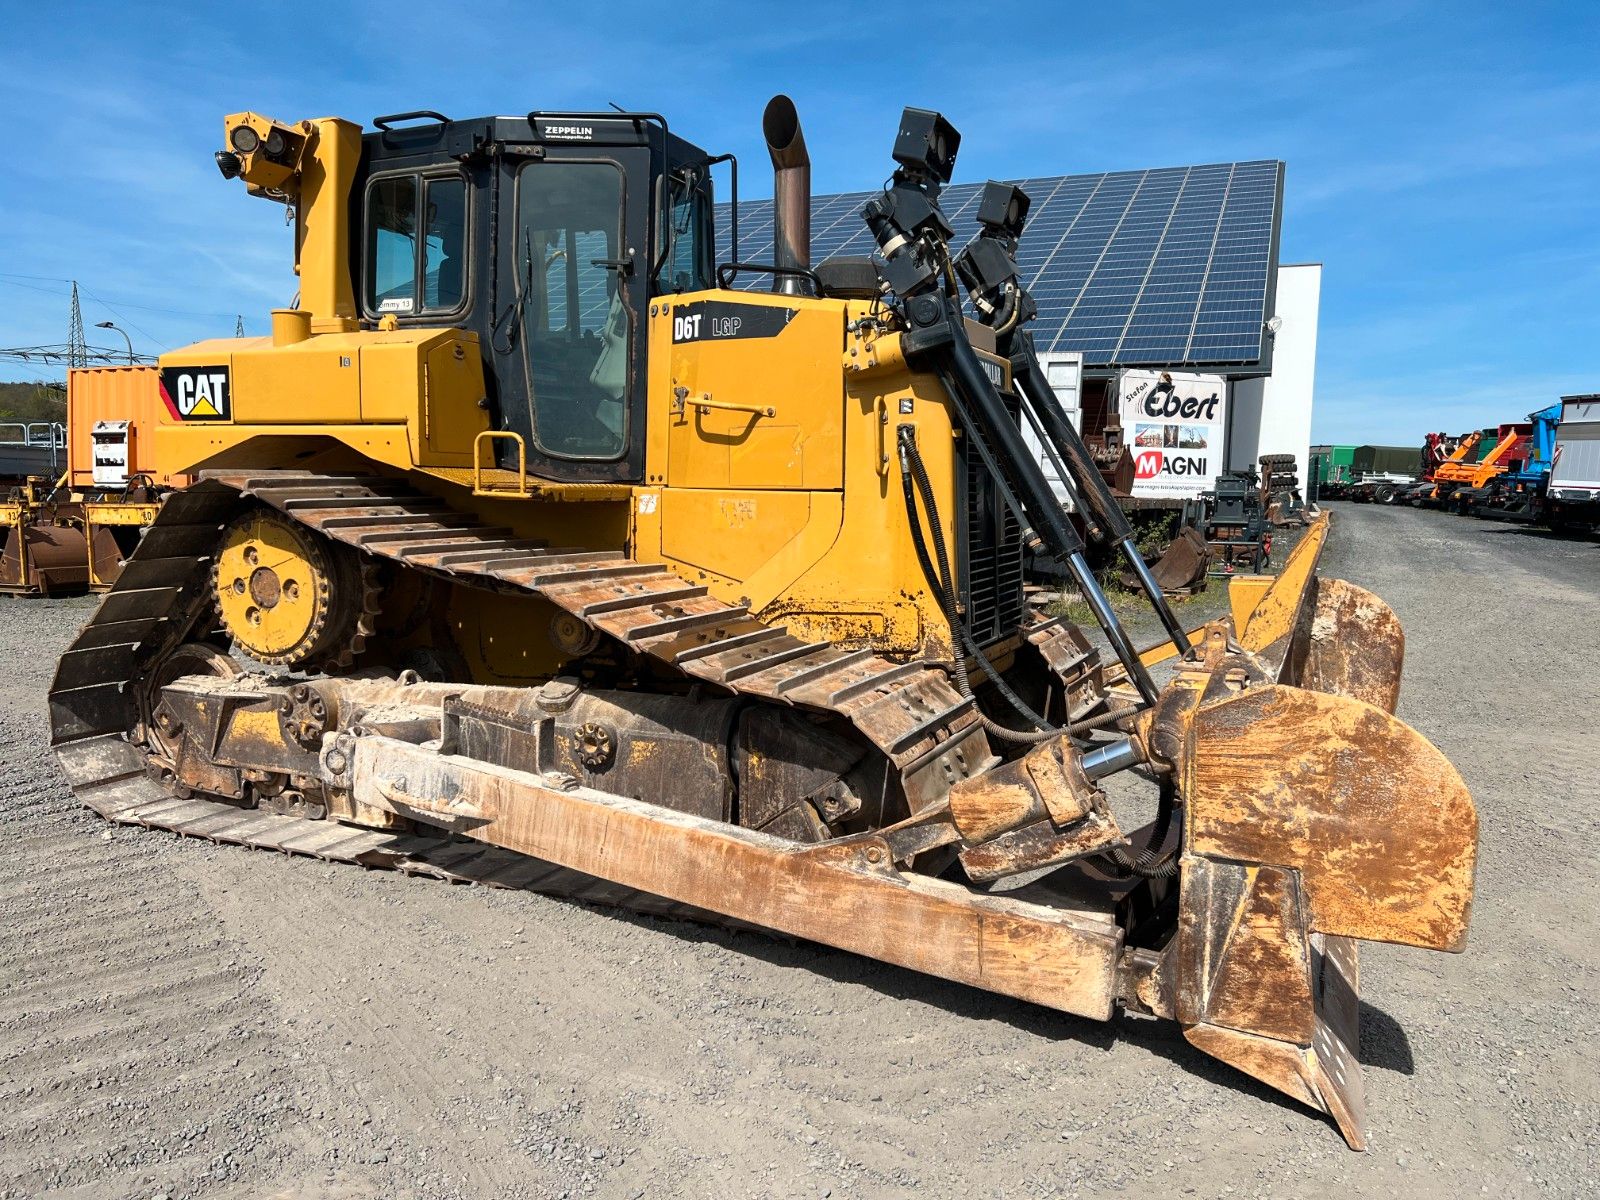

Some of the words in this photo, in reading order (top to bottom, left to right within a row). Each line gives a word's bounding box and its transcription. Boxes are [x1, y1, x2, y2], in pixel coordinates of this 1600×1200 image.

[545, 126, 592, 135] ZEPPELIN
[674, 313, 702, 340] D6T
[712, 317, 741, 336] LGP
[177, 373, 226, 415] CAT
[1125, 382, 1149, 402] Stefan
[1144, 382, 1219, 420] Ebert
[1137, 455, 1207, 476] MAGNI
